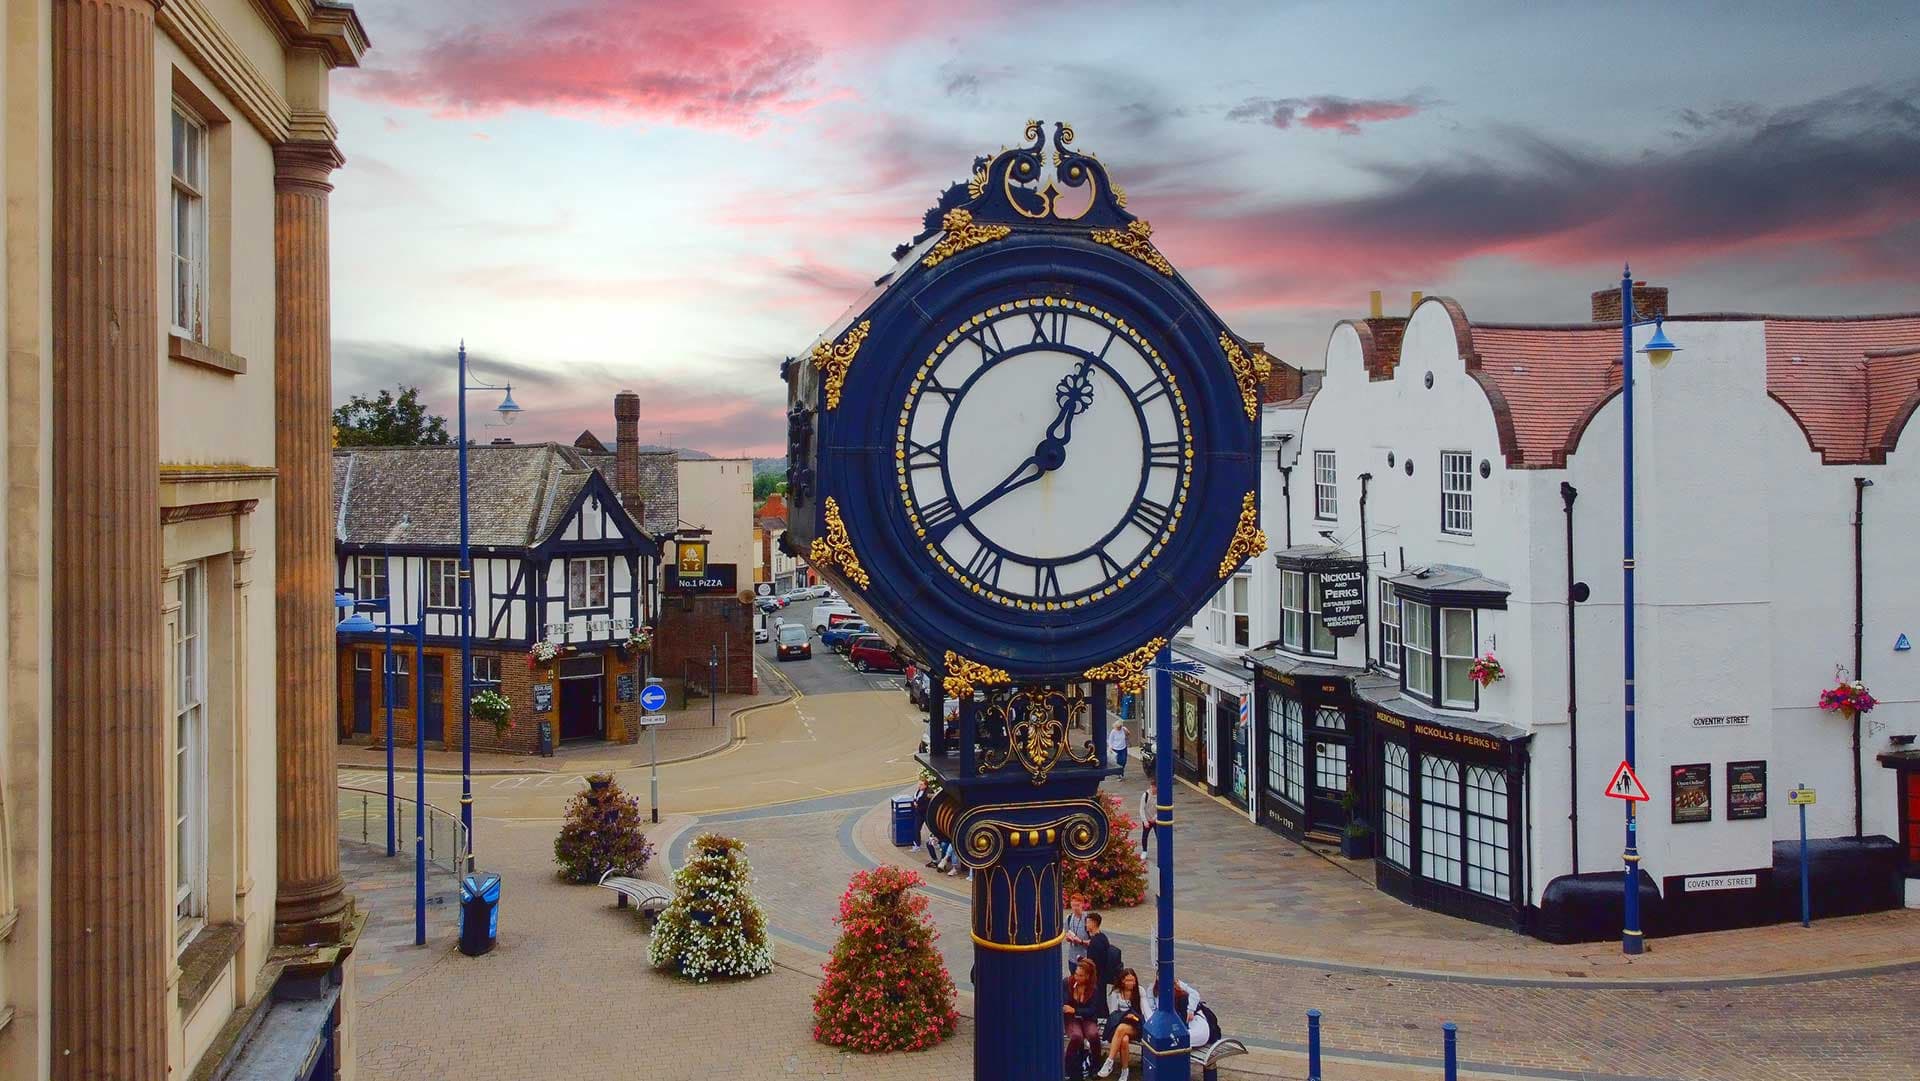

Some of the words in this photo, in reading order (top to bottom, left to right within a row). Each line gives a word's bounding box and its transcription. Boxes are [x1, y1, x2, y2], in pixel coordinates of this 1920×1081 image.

[1027, 311, 1068, 345] XII
[965, 325, 1006, 364] XI
[1099, 331, 1118, 361] I
[923, 373, 962, 408] X
[1133, 375, 1171, 407] II
[909, 438, 943, 470] IX
[1149, 441, 1180, 468] III
[1130, 497, 1171, 538] IIII
[964, 543, 1003, 588] VII
[1097, 549, 1125, 581] V
[1320, 572, 1361, 583] NICKOLLS
[1034, 565, 1062, 599] VI
[1325, 588, 1359, 599] PERKS
[1323, 600, 1362, 608] ESTABLISHED
[543, 622, 574, 636] THE
[586, 617, 634, 633] MITRE
[1327, 619, 1361, 627] MERCHANTS
[1376, 712, 1405, 729] MERCHANTS
[1693, 717, 1725, 726] COVENTRY
[1726, 715, 1750, 725] STREET
[1415, 724, 1454, 741] NICKOLLS
[1455, 733, 1462, 742] &
[1463, 736, 1490, 750] PERKS
[1687, 879, 1724, 889] COVENTRY
[1727, 877, 1753, 887] STREET
